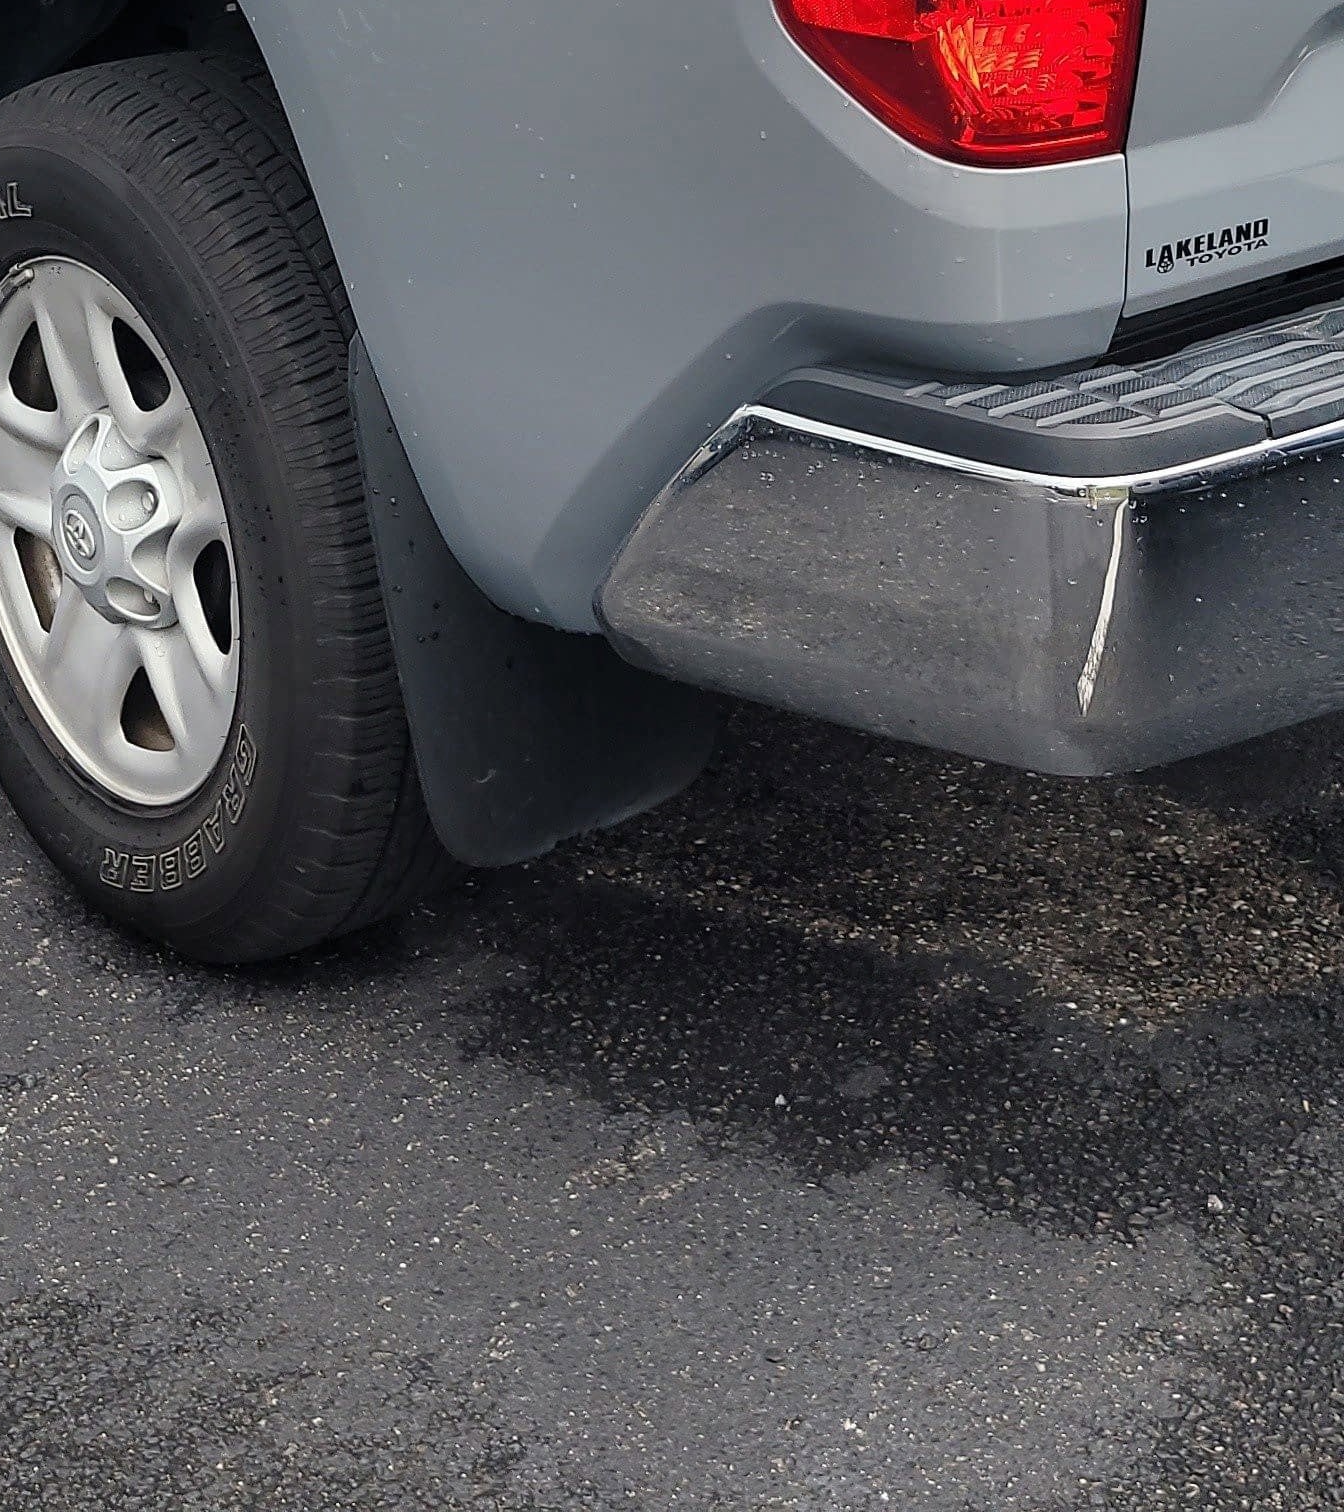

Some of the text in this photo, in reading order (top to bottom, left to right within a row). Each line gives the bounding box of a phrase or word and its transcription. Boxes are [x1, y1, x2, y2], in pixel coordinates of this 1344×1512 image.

[1145, 218, 1269, 273] LAKELAND
[1186, 238, 1269, 267] TOYOTA
[99, 724, 259, 893] GRABBER
